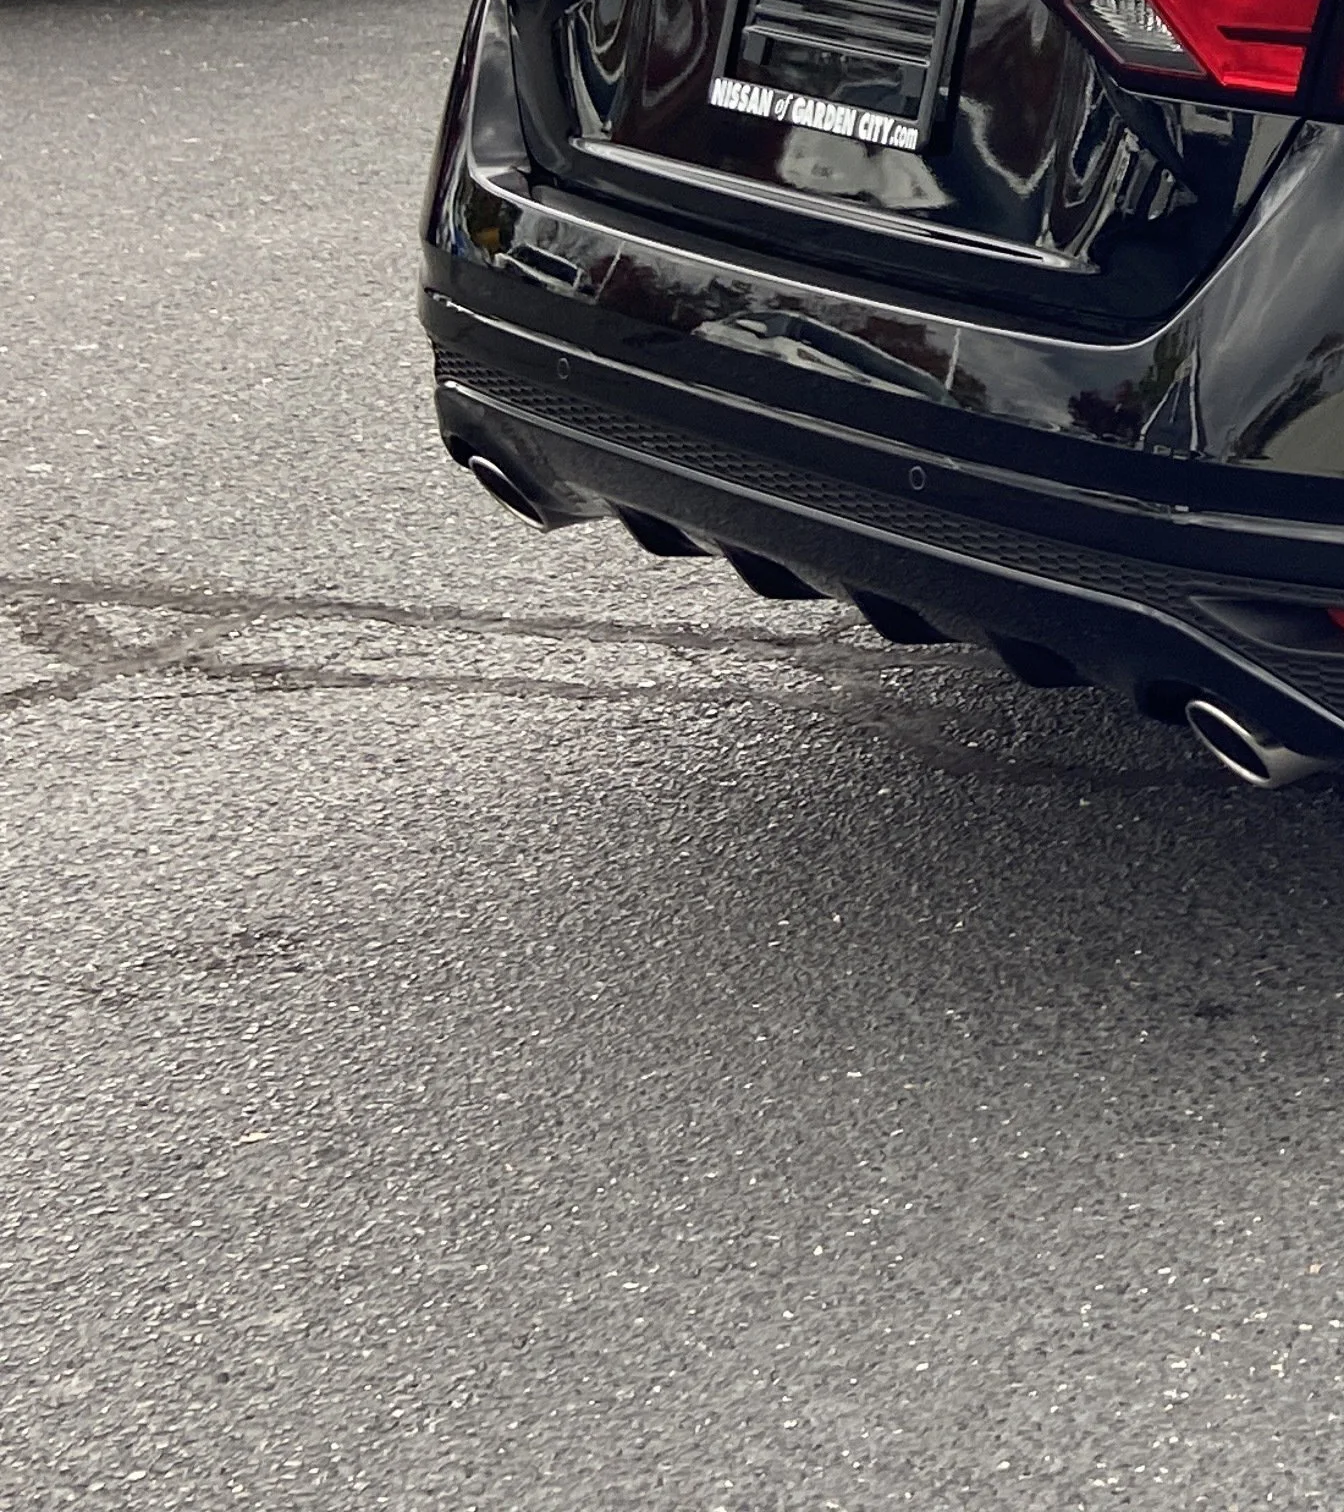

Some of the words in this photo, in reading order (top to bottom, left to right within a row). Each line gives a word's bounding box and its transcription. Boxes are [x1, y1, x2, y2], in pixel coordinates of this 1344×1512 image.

[711, 78, 774, 118] NISSAN
[774, 93, 794, 121] of
[791, 97, 857, 137] GARDEN
[858, 112, 919, 151] CITY.com
